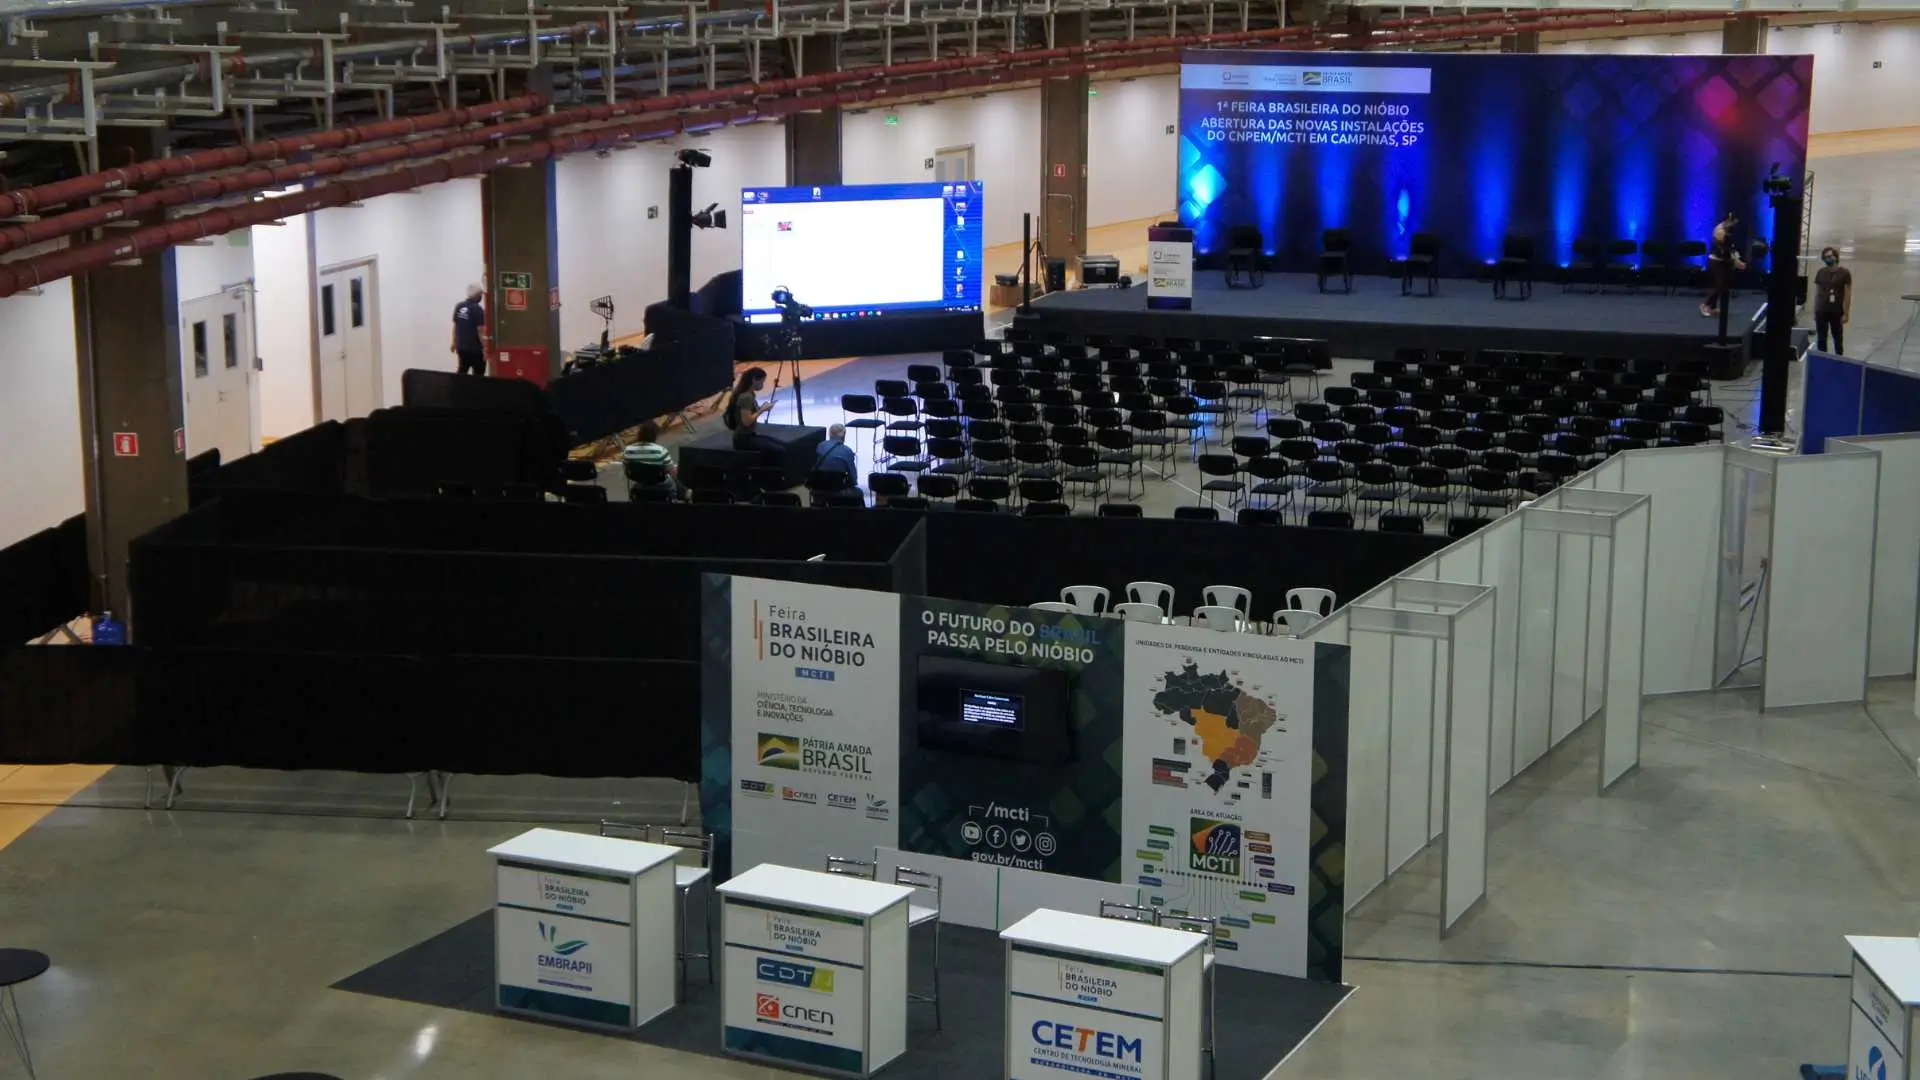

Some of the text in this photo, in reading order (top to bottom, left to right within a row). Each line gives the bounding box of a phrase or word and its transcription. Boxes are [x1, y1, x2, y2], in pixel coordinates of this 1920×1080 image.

[1231, 102, 1266, 113] FEIRA
[1268, 103, 1339, 115] BRASILEIRA
[1342, 104, 1361, 115] DO
[1364, 101, 1410, 116] NIÓBIO
[1201, 118, 1424, 134] ABERTURA DAS NOVAS INSTALAÇÕES
[1207, 131, 1418, 147] DO CNPEM/MCTI EM CAMPINAS, SP
[769, 605, 806, 621] Feira
[770, 622, 875, 648] BRASILEIRA
[922, 610, 1101, 646] O FUTURO DO BRASIL
[770, 642, 865, 667] DO NIÓBIO
[928, 630, 1094, 664] PASSA PELO NIÓBIO
[802, 668, 830, 680] MCTI
[802, 736, 872, 756] PÁTRIA AMADA
[802, 749, 872, 774] BRASIL
[984, 801, 1030, 822] /mcti
[972, 850, 1043, 871] gov.br/mcti
[1193, 854, 1234, 874] MCTI
[774, 924, 822, 938] BRASILEIRA
[774, 932, 817, 946] DO NIÓBIO
[538, 954, 592, 974] EMBRAPII
[1065, 972, 1118, 990] BRASILEIRA
[1065, 982, 1078, 991] DO
[1081, 983, 1113, 998] NIÓBIO
[1032, 1020, 1142, 1063] CETEM
[1034, 1047, 1060, 1058] CENTRO
[1060, 1052, 1070, 1060] DE
[1070, 1054, 1112, 1068] TECNOLOGIA
[1114, 1062, 1142, 1073] MINERAL
